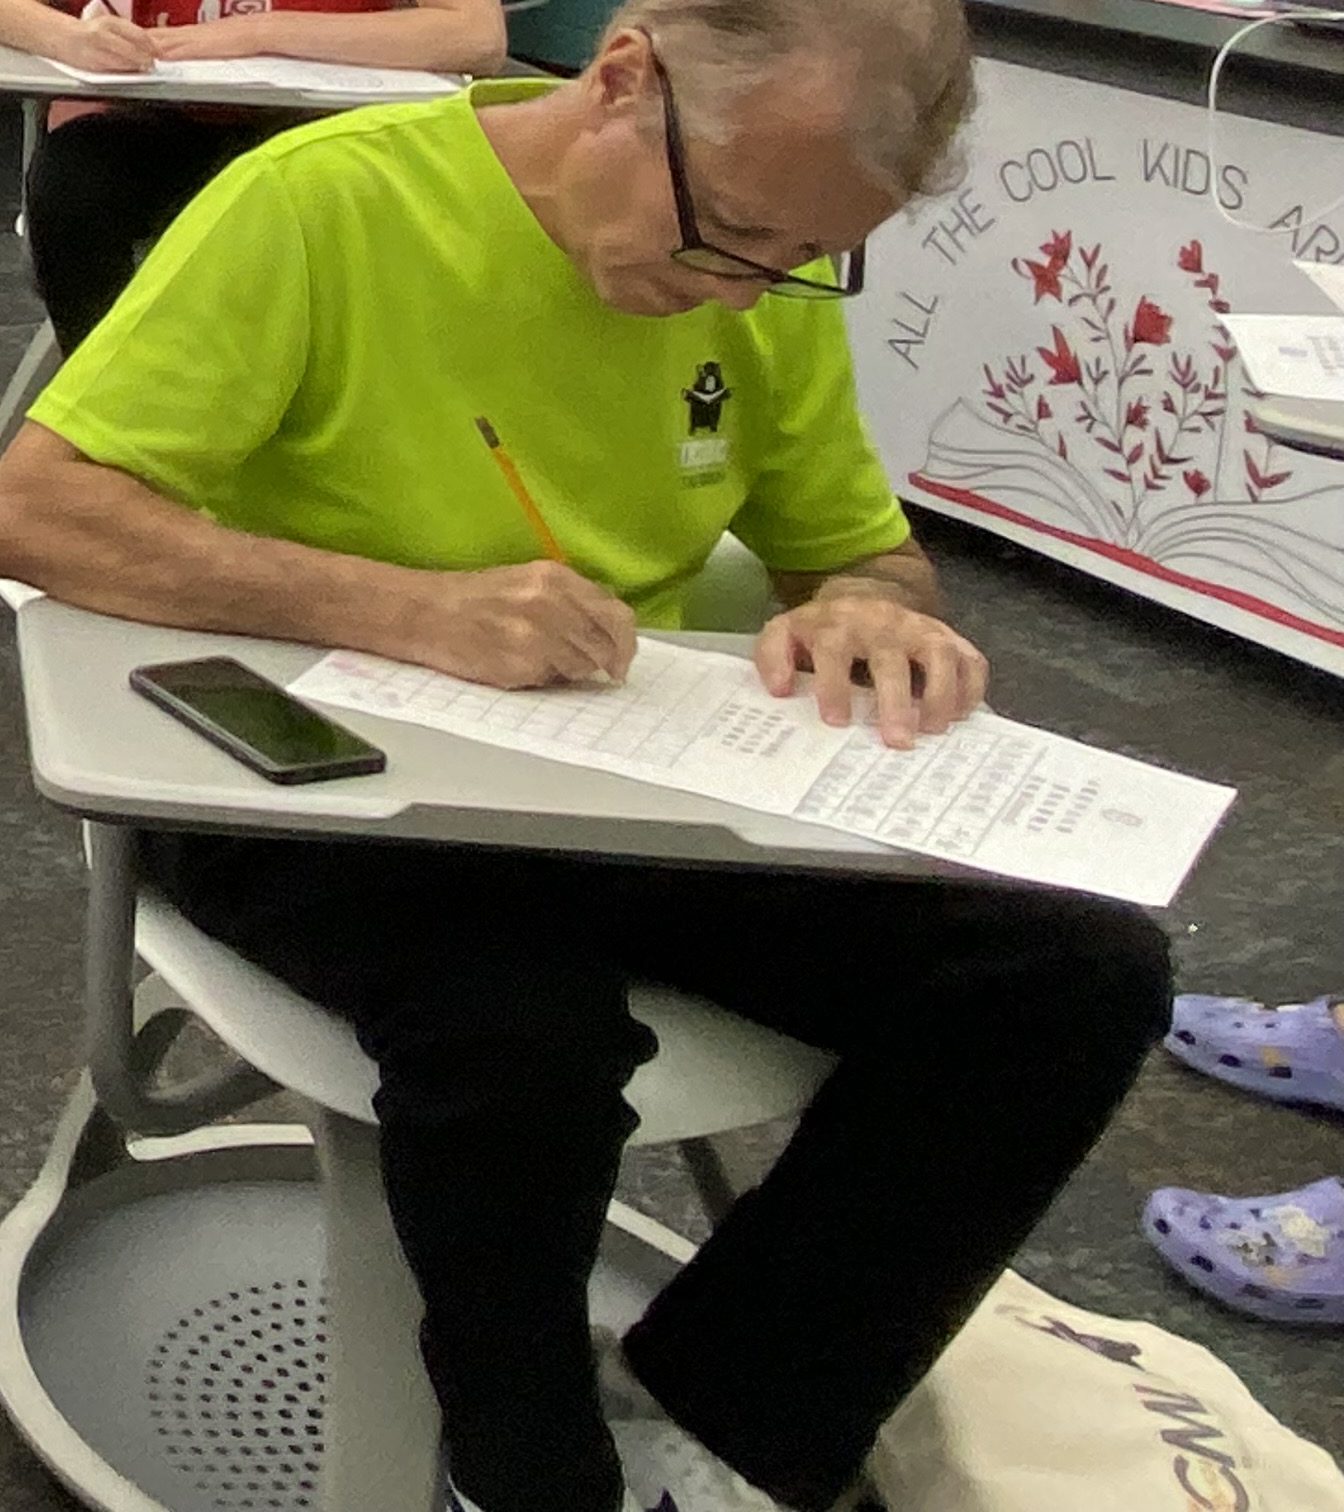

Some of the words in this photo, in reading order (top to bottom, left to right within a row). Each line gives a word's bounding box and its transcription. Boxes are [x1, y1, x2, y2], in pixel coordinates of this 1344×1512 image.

[886, 290, 939, 371] ALL
[921, 188, 996, 266] THE
[999, 137, 1116, 204] COOL
[1142, 138, 1250, 210] KIDS
[1268, 203, 1344, 265] AR
